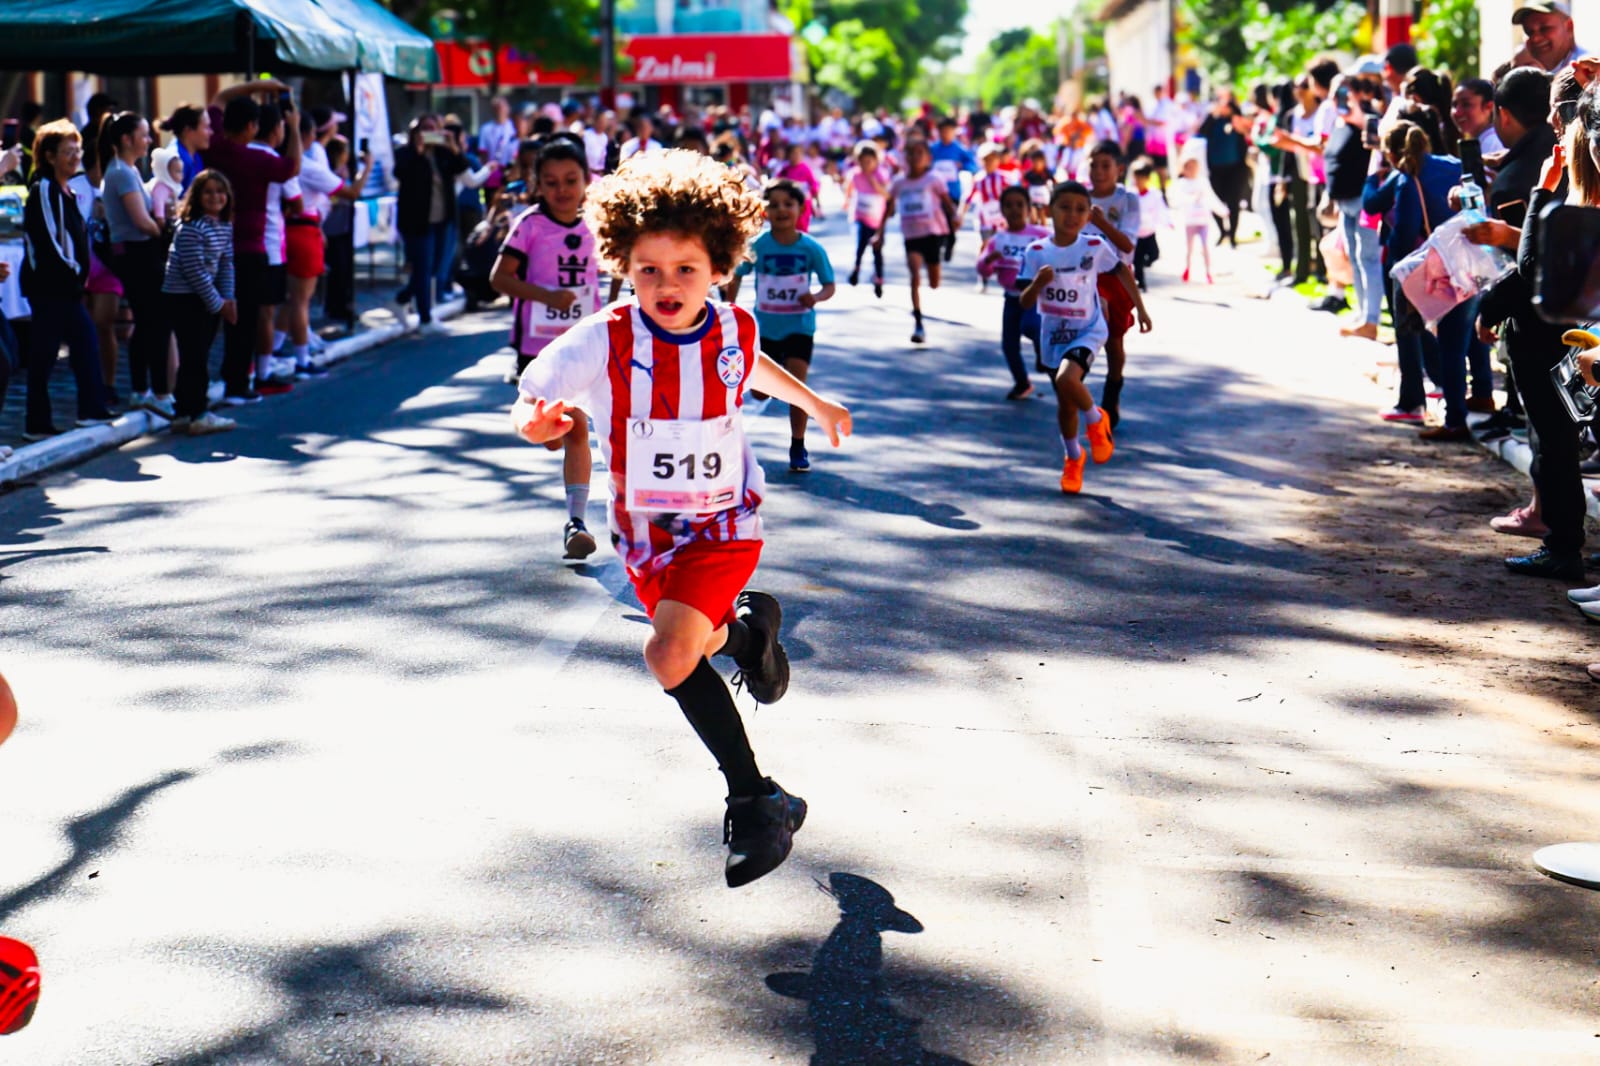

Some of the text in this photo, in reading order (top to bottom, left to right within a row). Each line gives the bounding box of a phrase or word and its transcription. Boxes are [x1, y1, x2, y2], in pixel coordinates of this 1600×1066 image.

[767, 288, 797, 301] 547
[1046, 287, 1078, 303] 509
[652, 452, 722, 480] 519
